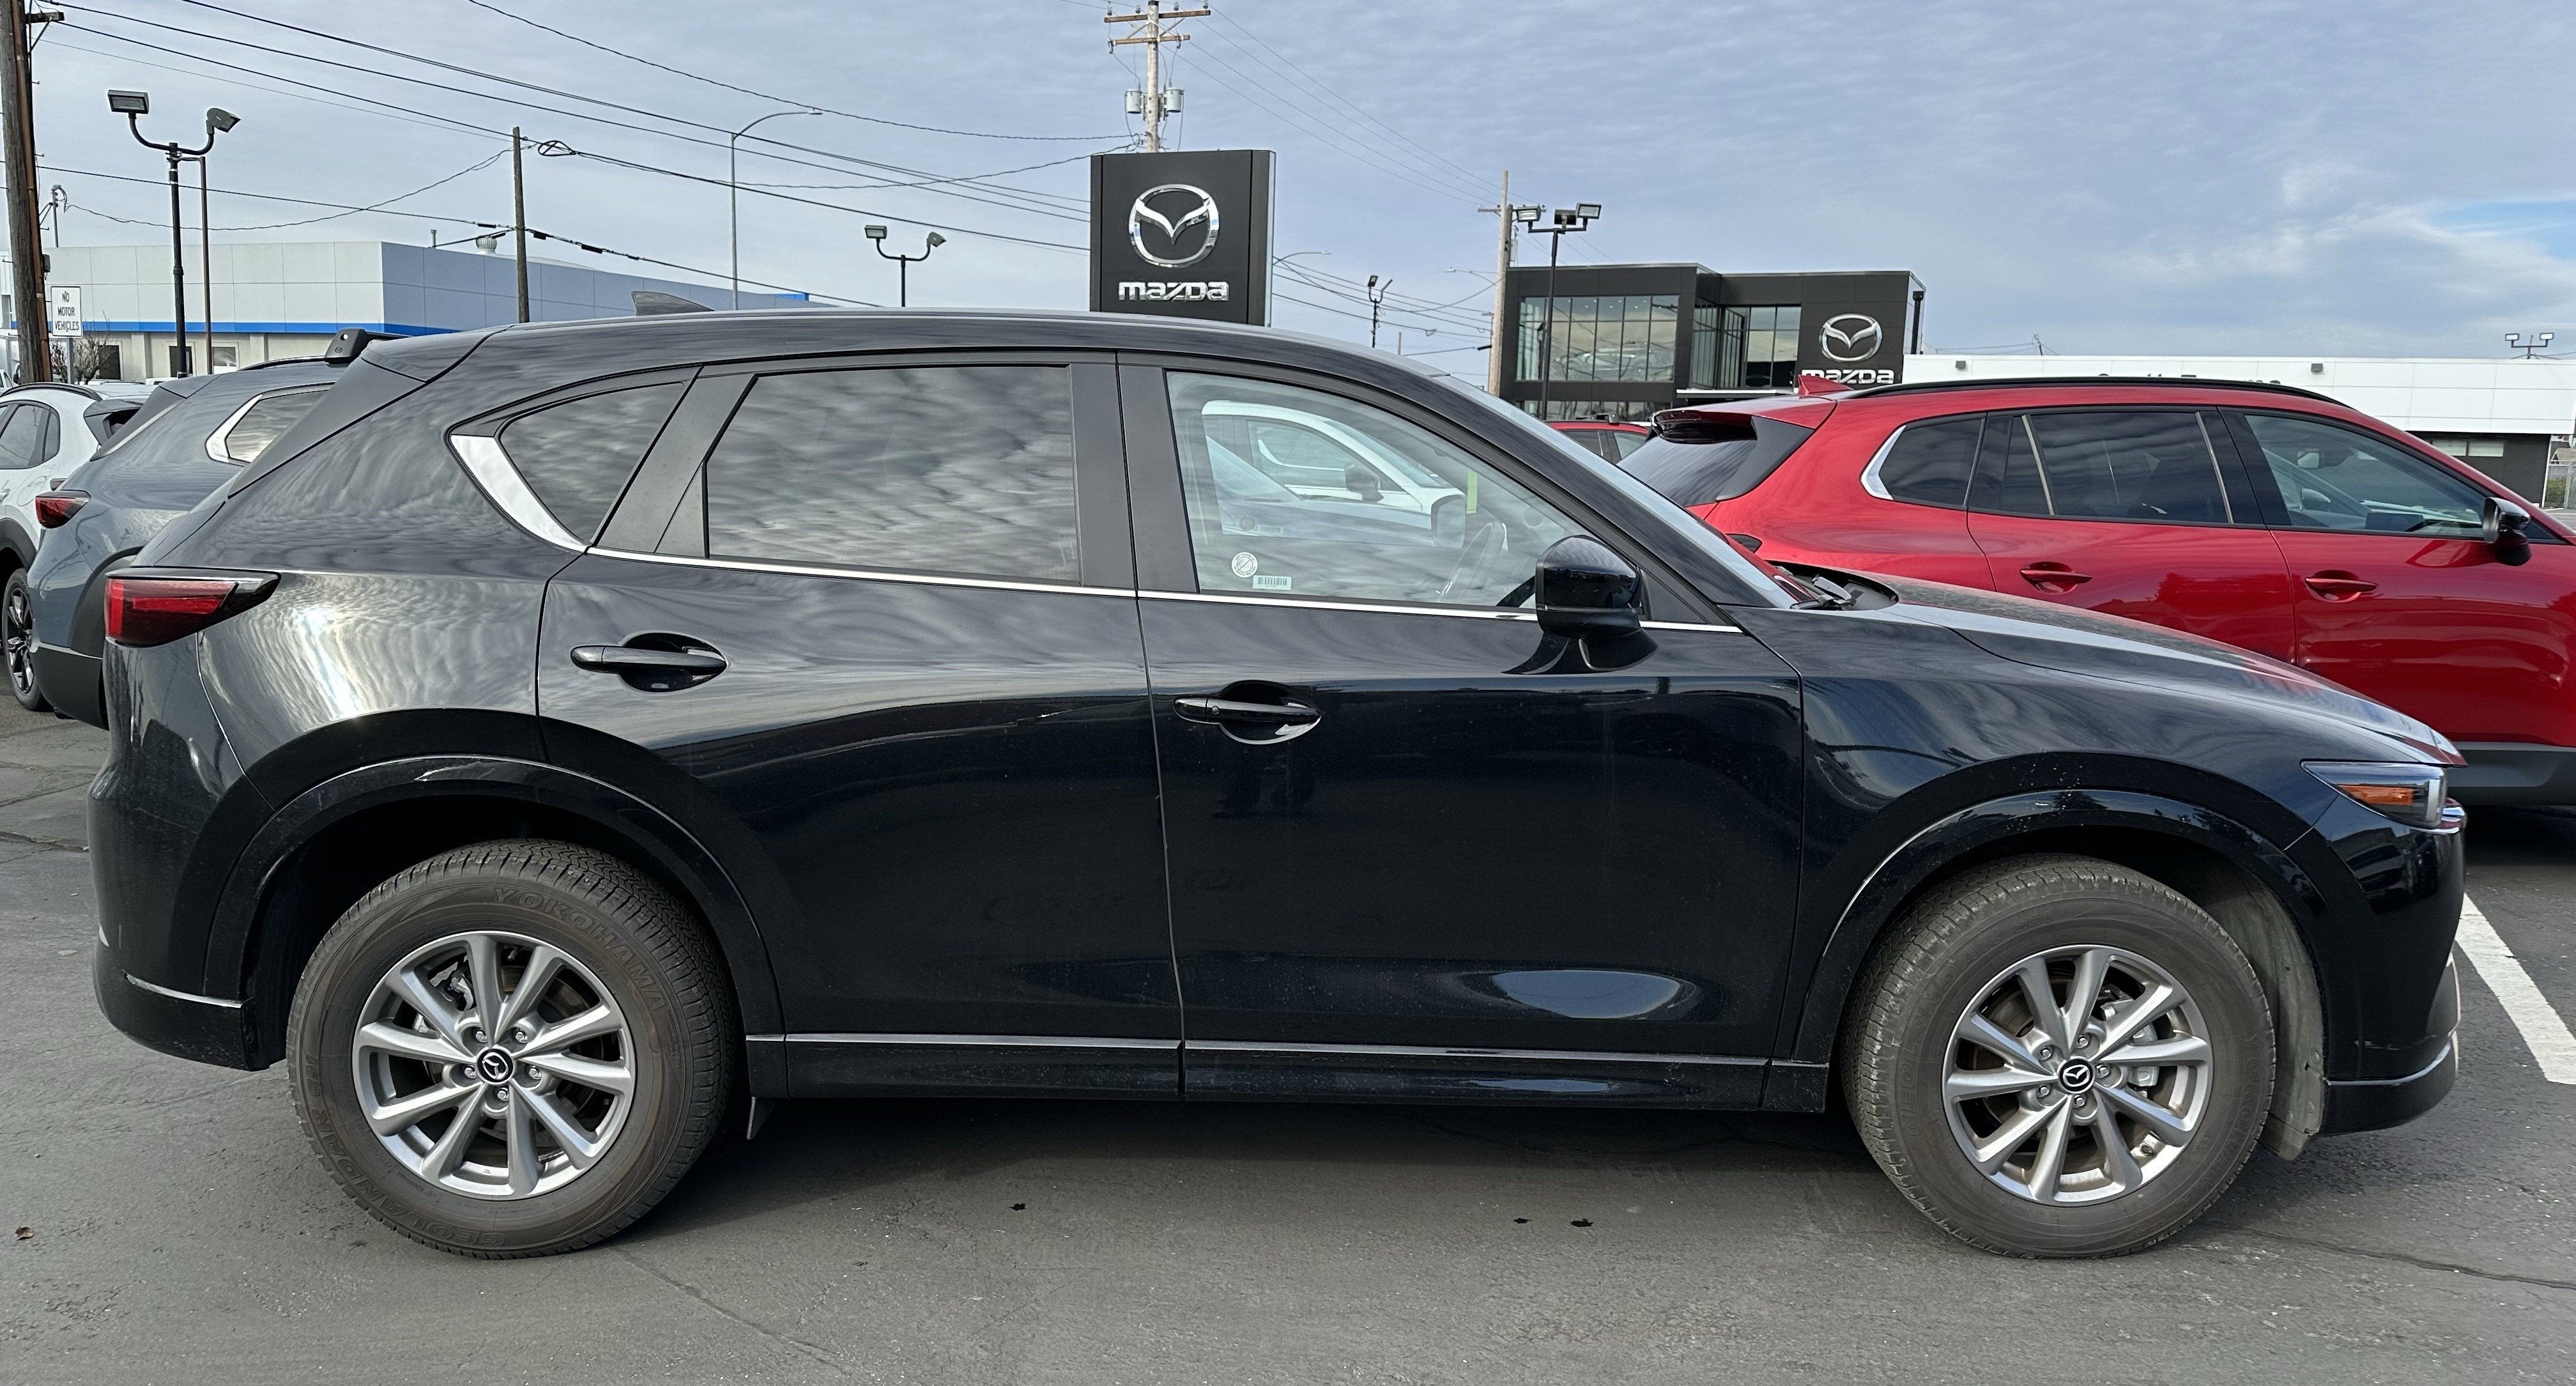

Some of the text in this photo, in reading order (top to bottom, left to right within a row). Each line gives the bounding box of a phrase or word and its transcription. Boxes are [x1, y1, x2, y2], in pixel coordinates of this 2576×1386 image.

[62, 291, 70, 302] NO
[1119, 281, 1229, 301] mazda
[57, 307, 75, 316] MOTOR
[54, 321, 79, 330] VEHICLES
[494, 887, 667, 1012] YOKOHAMA
[310, 1108, 507, 1247] GEOLANDAR
